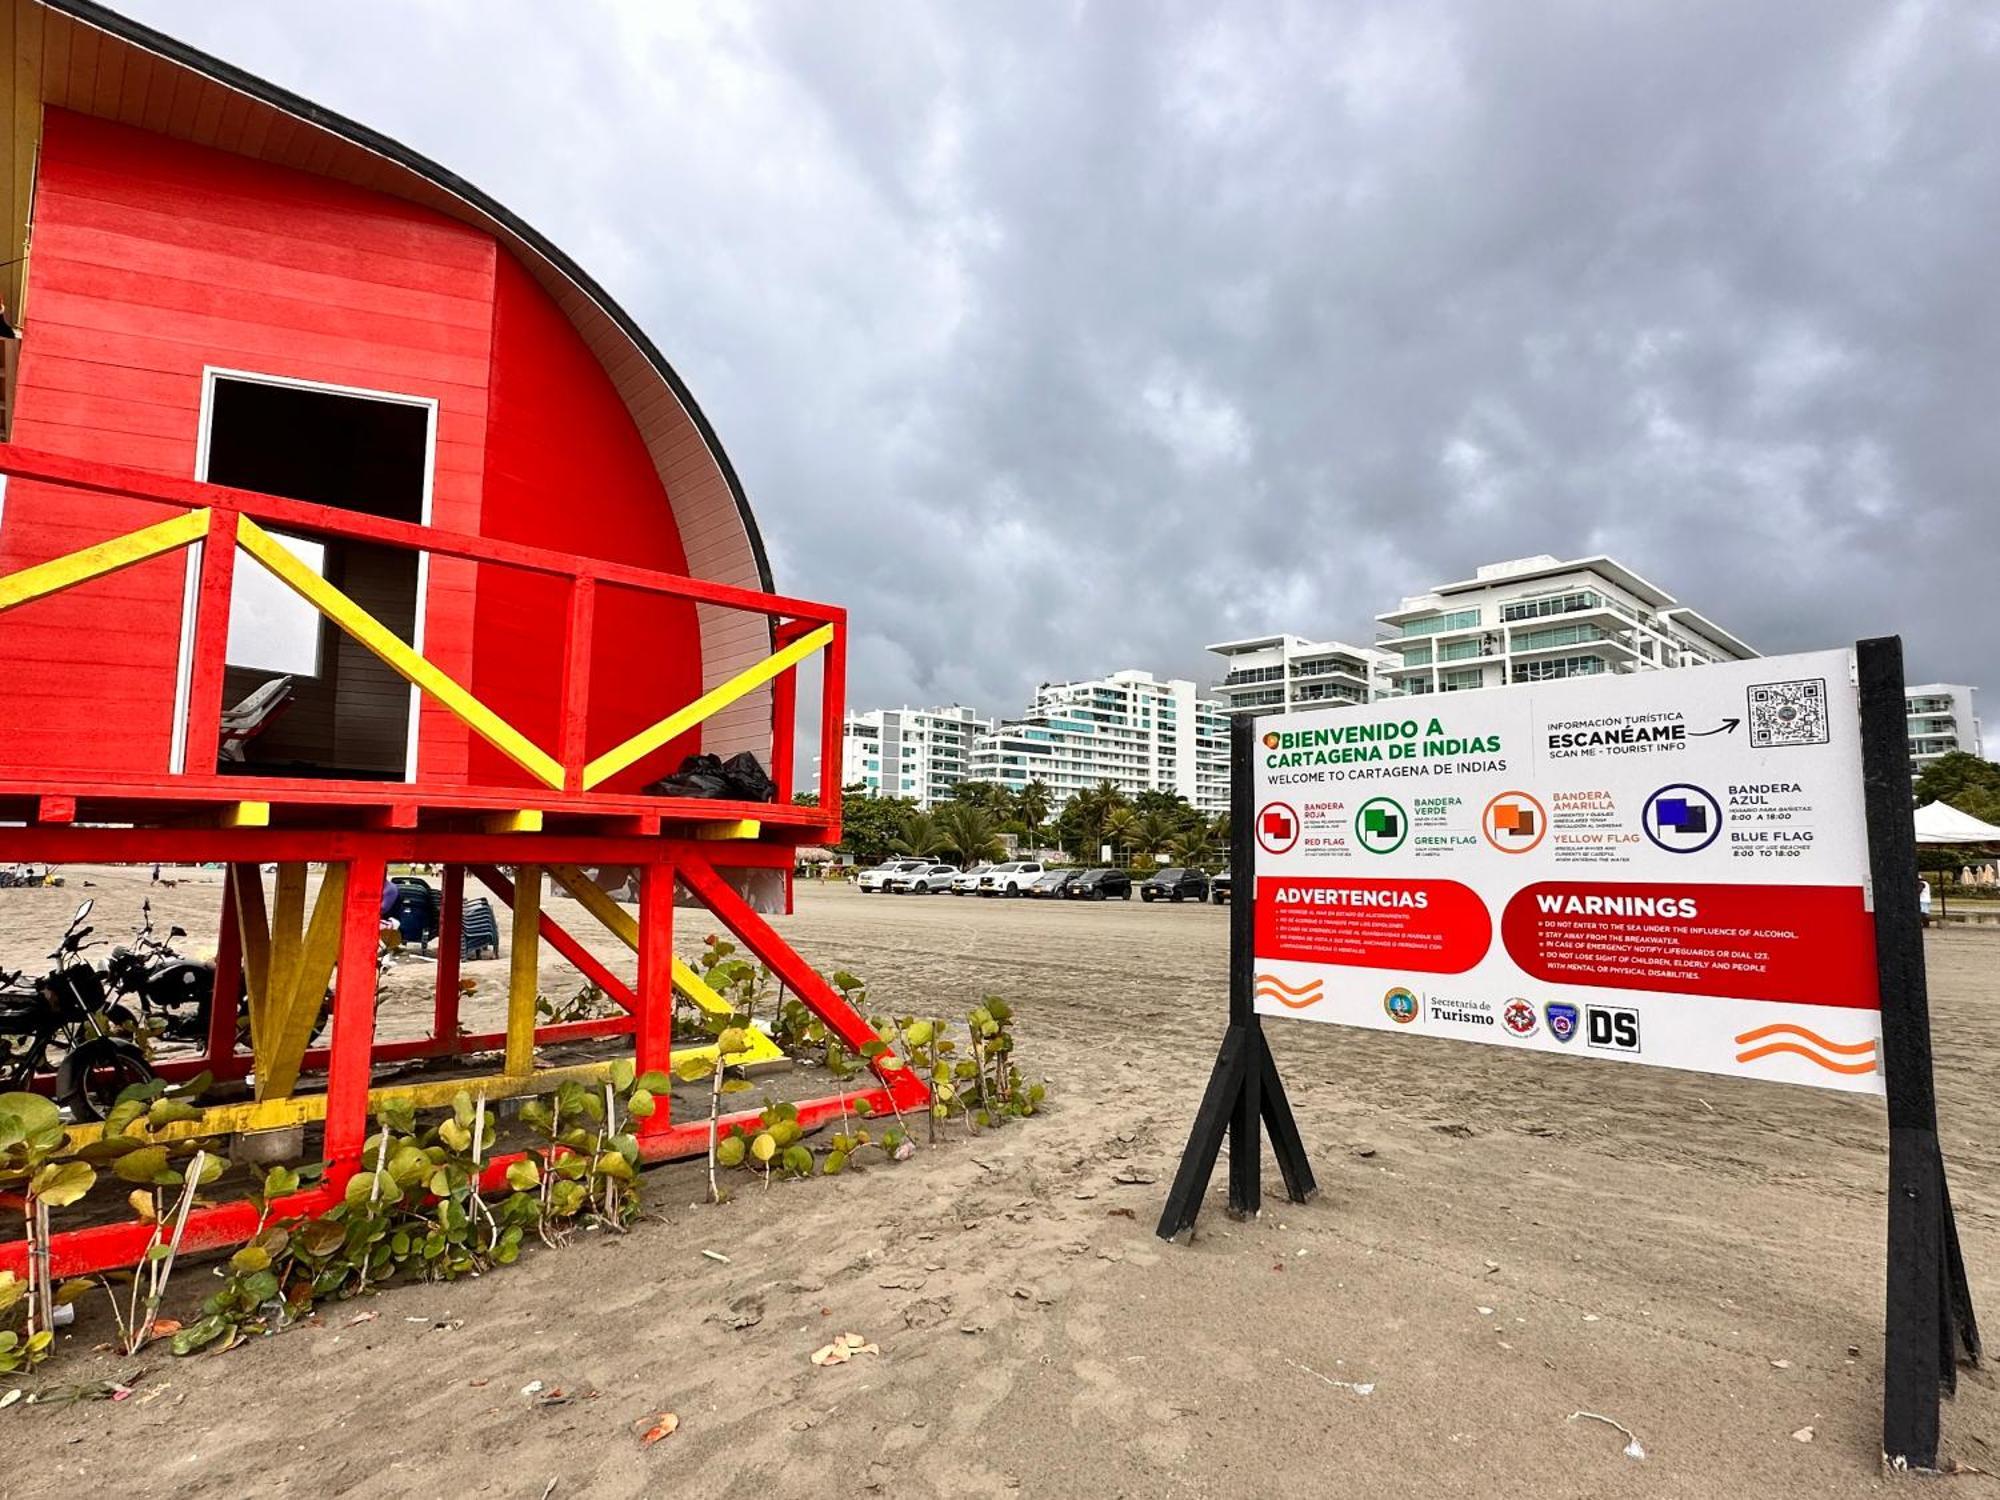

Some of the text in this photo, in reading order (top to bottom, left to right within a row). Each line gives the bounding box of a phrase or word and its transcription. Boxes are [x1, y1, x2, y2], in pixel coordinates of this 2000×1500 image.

[1548, 712, 1683, 731] INFORMACIÓN TURÍSTICA
[1281, 718, 1444, 750] BIENVENIDO A
[1549, 725, 1686, 749] ESCANÉAME
[1266, 736, 1500, 768] CARTAGENA DE INDIAS
[1550, 750, 1578, 760] SCAN
[1580, 749, 1596, 757] ME
[1607, 744, 1653, 756] TOURIST
[1657, 742, 1686, 751] INFO
[1268, 760, 1506, 784] WELCOME TO CARTAGENA DE INDIAS
[1728, 783, 1802, 795] BANDERA
[1414, 797, 1462, 806] BANDERA
[1553, 791, 1611, 801] BANDERA
[1729, 795, 1768, 805] AZUL
[1304, 802, 1344, 810] BANDERA
[1414, 807, 1447, 815] VERDE
[1553, 801, 1615, 811] AMARILLA
[1414, 836, 1476, 844] GREEN FLAG
[1553, 834, 1640, 843] YELLOW FLAG
[1731, 832, 1814, 842] BLUE FLAG
[1275, 888, 1428, 908] ADVERTENCIAS
[1536, 894, 1697, 918] WARNINGS
[1644, 925, 1670, 933] UNDER
[1690, 927, 1736, 936] INFLUENCE
[1753, 930, 1799, 939] ALCOHOL.
[1587, 943, 1632, 952] EMERGENCY
[1664, 948, 1715, 957] LIFEGUARDS
[1567, 964, 1596, 972] MENTAL
[1610, 966, 1646, 976] PHYSICAL
[1674, 959, 1710, 968] ELDERLY
[1732, 963, 1766, 972] PEOPLE
[1479, 1001, 1491, 1011] de
[1431, 1008, 1494, 1025] Turismo
[1590, 1010, 1637, 1047] DS
